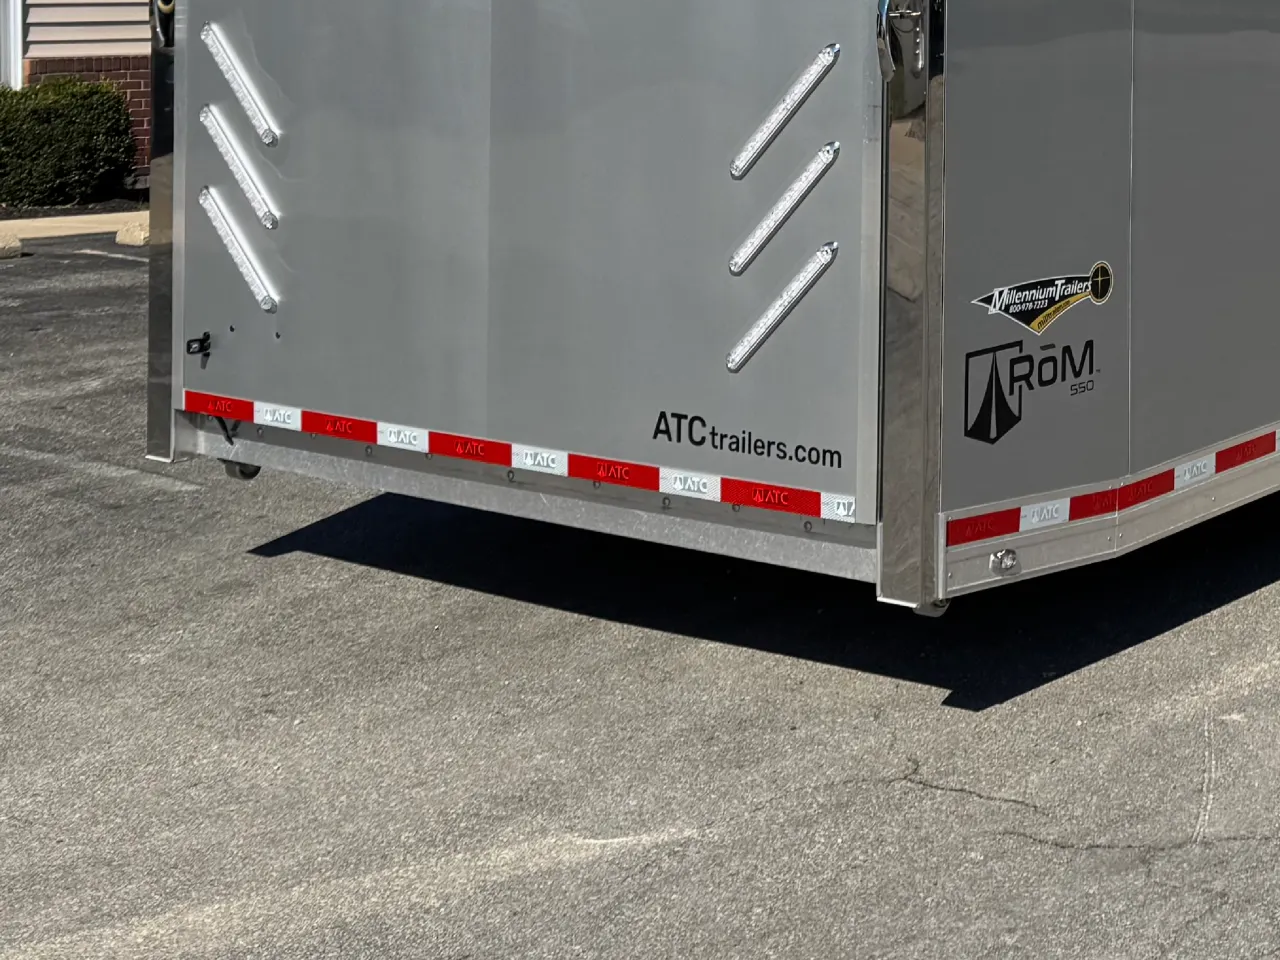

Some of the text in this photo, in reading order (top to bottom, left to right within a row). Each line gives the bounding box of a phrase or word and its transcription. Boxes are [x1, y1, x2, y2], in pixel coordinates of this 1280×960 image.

[1070, 379, 1095, 396] 550
[273, 409, 292, 423] ATC
[335, 420, 352, 433] ATC
[398, 430, 419, 445] ATC
[465, 443, 485, 456] ATC
[533, 452, 557, 468] ATC
[608, 465, 630, 480] ATC
[1190, 459, 1208, 479] ATC
[685, 477, 708, 494] ATC
[765, 489, 789, 505] ATC
[1041, 503, 1060, 520] ATC
